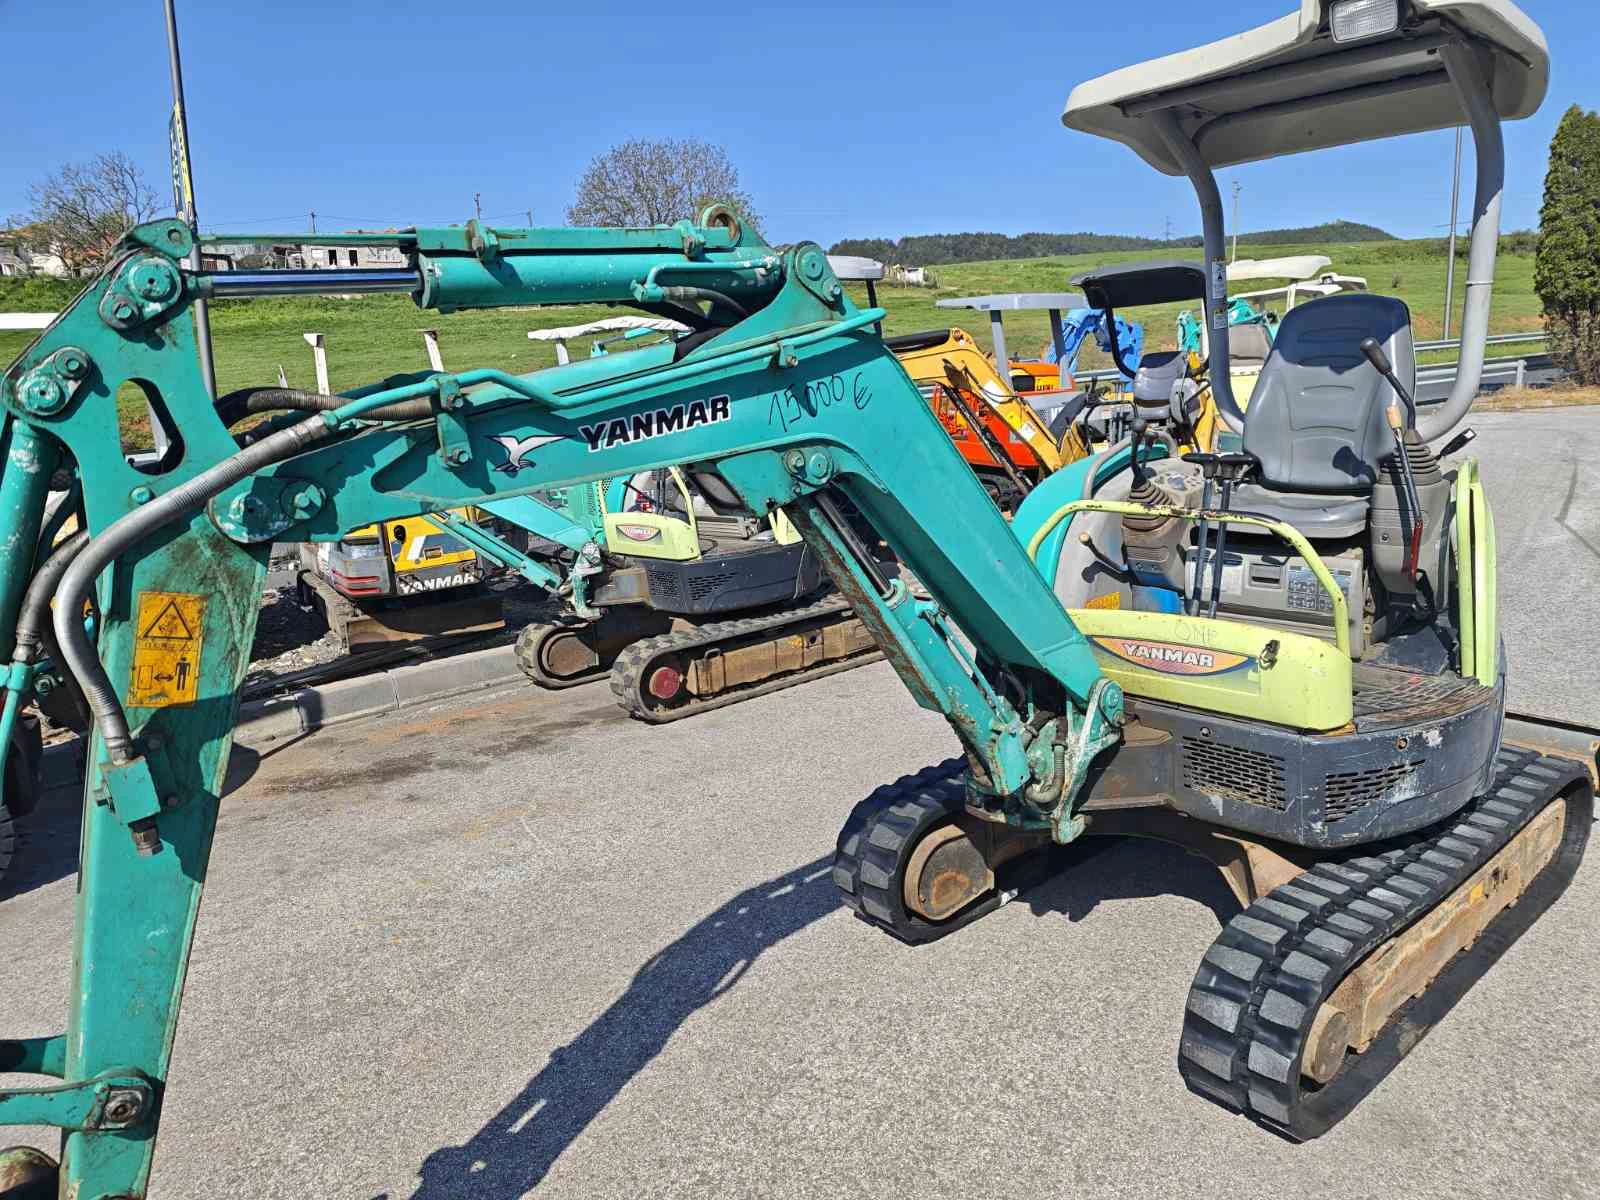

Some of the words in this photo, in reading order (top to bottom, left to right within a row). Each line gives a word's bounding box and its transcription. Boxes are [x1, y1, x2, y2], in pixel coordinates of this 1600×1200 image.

[579, 395, 730, 453] YANMAR
[768, 376, 845, 432] 15000
[854, 371, 872, 410] €
[1123, 643, 1214, 667] YANMAR
